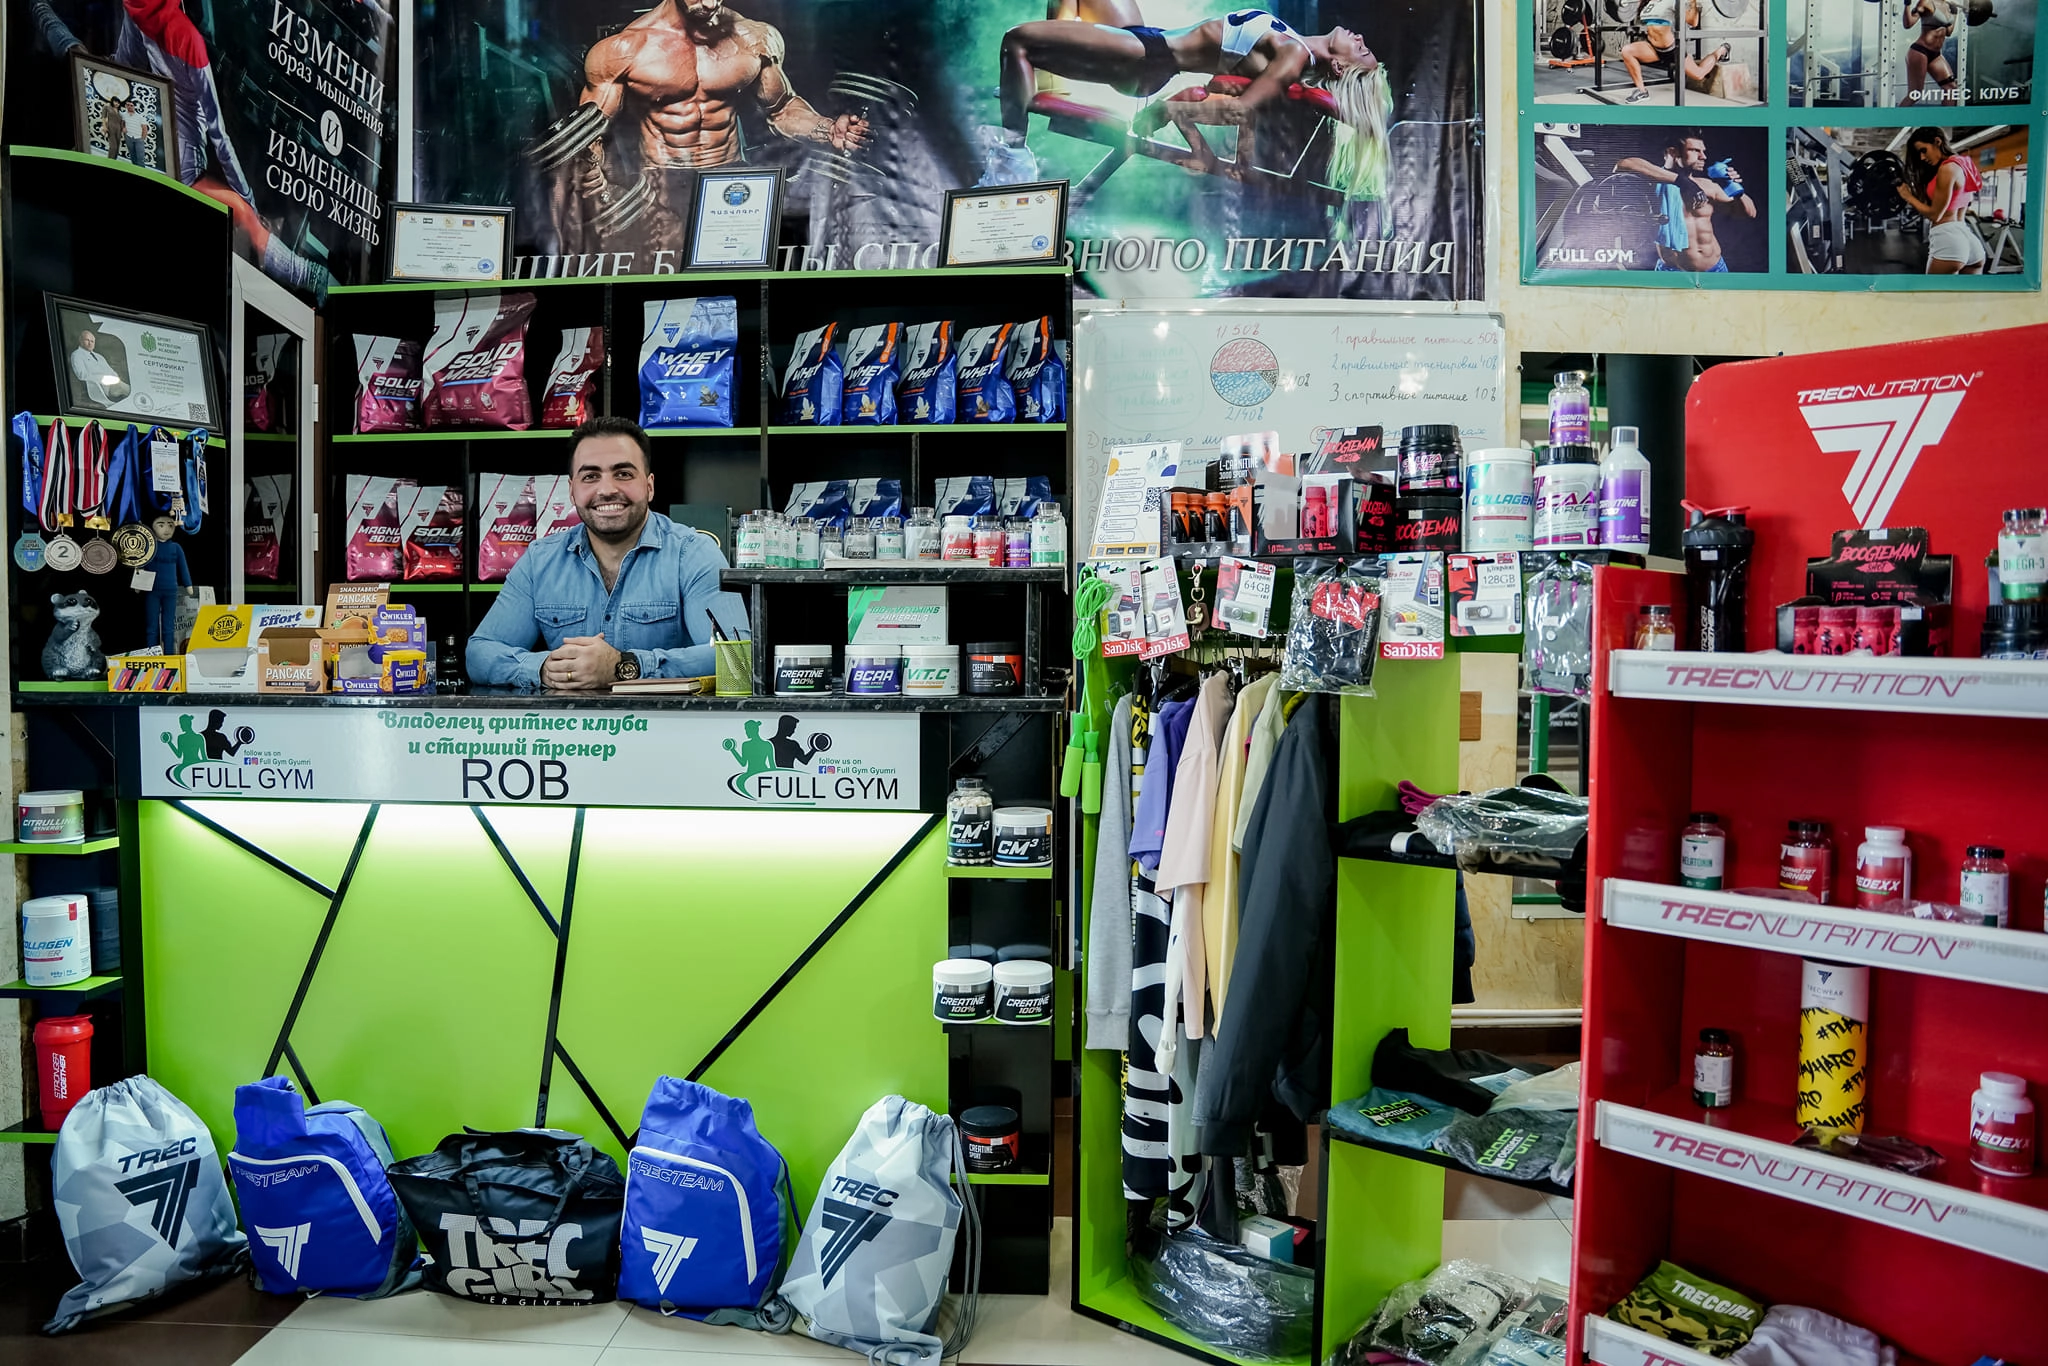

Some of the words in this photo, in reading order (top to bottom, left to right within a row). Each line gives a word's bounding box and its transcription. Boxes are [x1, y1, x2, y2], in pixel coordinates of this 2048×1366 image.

[269, 1, 386, 114] ИЗМЕНИ
[268, 41, 312, 84] образ
[315, 81, 384, 138] мышления
[1908, 88, 1972, 101] ФИТНЕС
[1979, 87, 2019, 100] КЛУБ
[325, 118, 341, 148] И
[266, 129, 382, 220] ИЗМЕНИШЬ
[265, 163, 325, 213] СВОЮ
[328, 198, 380, 246] ЖИЗНЬ
[1222, 236, 1455, 275] ПИТАНИЯ
[1548, 247, 1589, 263] FULL
[1593, 247, 1634, 263] GYM
[449, 341, 523, 369] SOLID
[658, 348, 731, 365] WHEY
[143, 360, 185, 372] СЕРТИФИКАТ
[440, 360, 508, 383] MASS
[664, 363, 705, 377] 100
[848, 364, 891, 380] WHEY
[907, 362, 943, 381] WHEY
[959, 361, 1000, 380] WHEY
[1013, 360, 1045, 381] WHEY
[373, 376, 422, 389] SOLID
[1344, 385, 1416, 405] спортивное
[1423, 392, 1468, 402] питание
[1219, 456, 1258, 473] L-CARNITINE
[1471, 494, 1534, 506] COLLAGEN
[358, 525, 401, 536] MAGNU
[491, 524, 538, 534] MAGNU
[58, 546, 69, 557] 2
[1835, 540, 1922, 564] BOOGIEMAN
[1244, 580, 1271, 594] 64GB
[1483, 575, 1516, 584] 128GB
[336, 594, 378, 604] PANCAKE
[216, 619, 235, 629] STAY
[259, 611, 303, 628] Effort
[1700, 605, 1708, 652] TRONGER
[1707, 609, 1715, 653] OGETHER
[1104, 641, 1143, 655] SanDisk
[1383, 639, 1440, 657] SanDisk
[125, 661, 166, 670] EFFORT
[265, 667, 313, 680] PANCAKE
[780, 669, 824, 679] CREATINE
[907, 668, 950, 680] VIT.C
[972, 663, 995, 672] CREATINE
[853, 670, 894, 681] BCAA
[377, 709, 485, 734] Владелец
[487, 712, 579, 735] фитнес
[582, 714, 649, 735] клуба
[244, 749, 262, 757] follow
[408, 742, 421, 755] и
[424, 736, 528, 758] старший
[532, 738, 617, 761] тренер
[272, 758, 287, 767] Gym
[289, 758, 311, 767] Gyumri
[818, 757, 839, 765] follow
[192, 767, 251, 789] FULL
[258, 767, 314, 790] GYM
[461, 758, 570, 801] ROB
[836, 766, 849, 774] Full
[851, 766, 867, 776] Gym
[870, 766, 896, 776] Gyumri
[757, 775, 826, 799] FULL
[834, 776, 898, 800] GYM
[940, 995, 986, 1005] CREATINE
[1006, 994, 1049, 1007] CREATINE
[951, 1005, 976, 1013] 100%
[1018, 1006, 1042, 1014] 100%
[52, 1052, 61, 1099] STRONGER
[59, 1054, 68, 1100] TOGETHER
[117, 1136, 198, 1174] TREC
[968, 1144, 993, 1154] CREATINE
[630, 1158, 725, 1192] TRECTEAM
[831, 1175, 900, 1208] TREC
[439, 1212, 584, 1279] TREC
[1670, 1279, 1755, 1322] TRECGIRL
